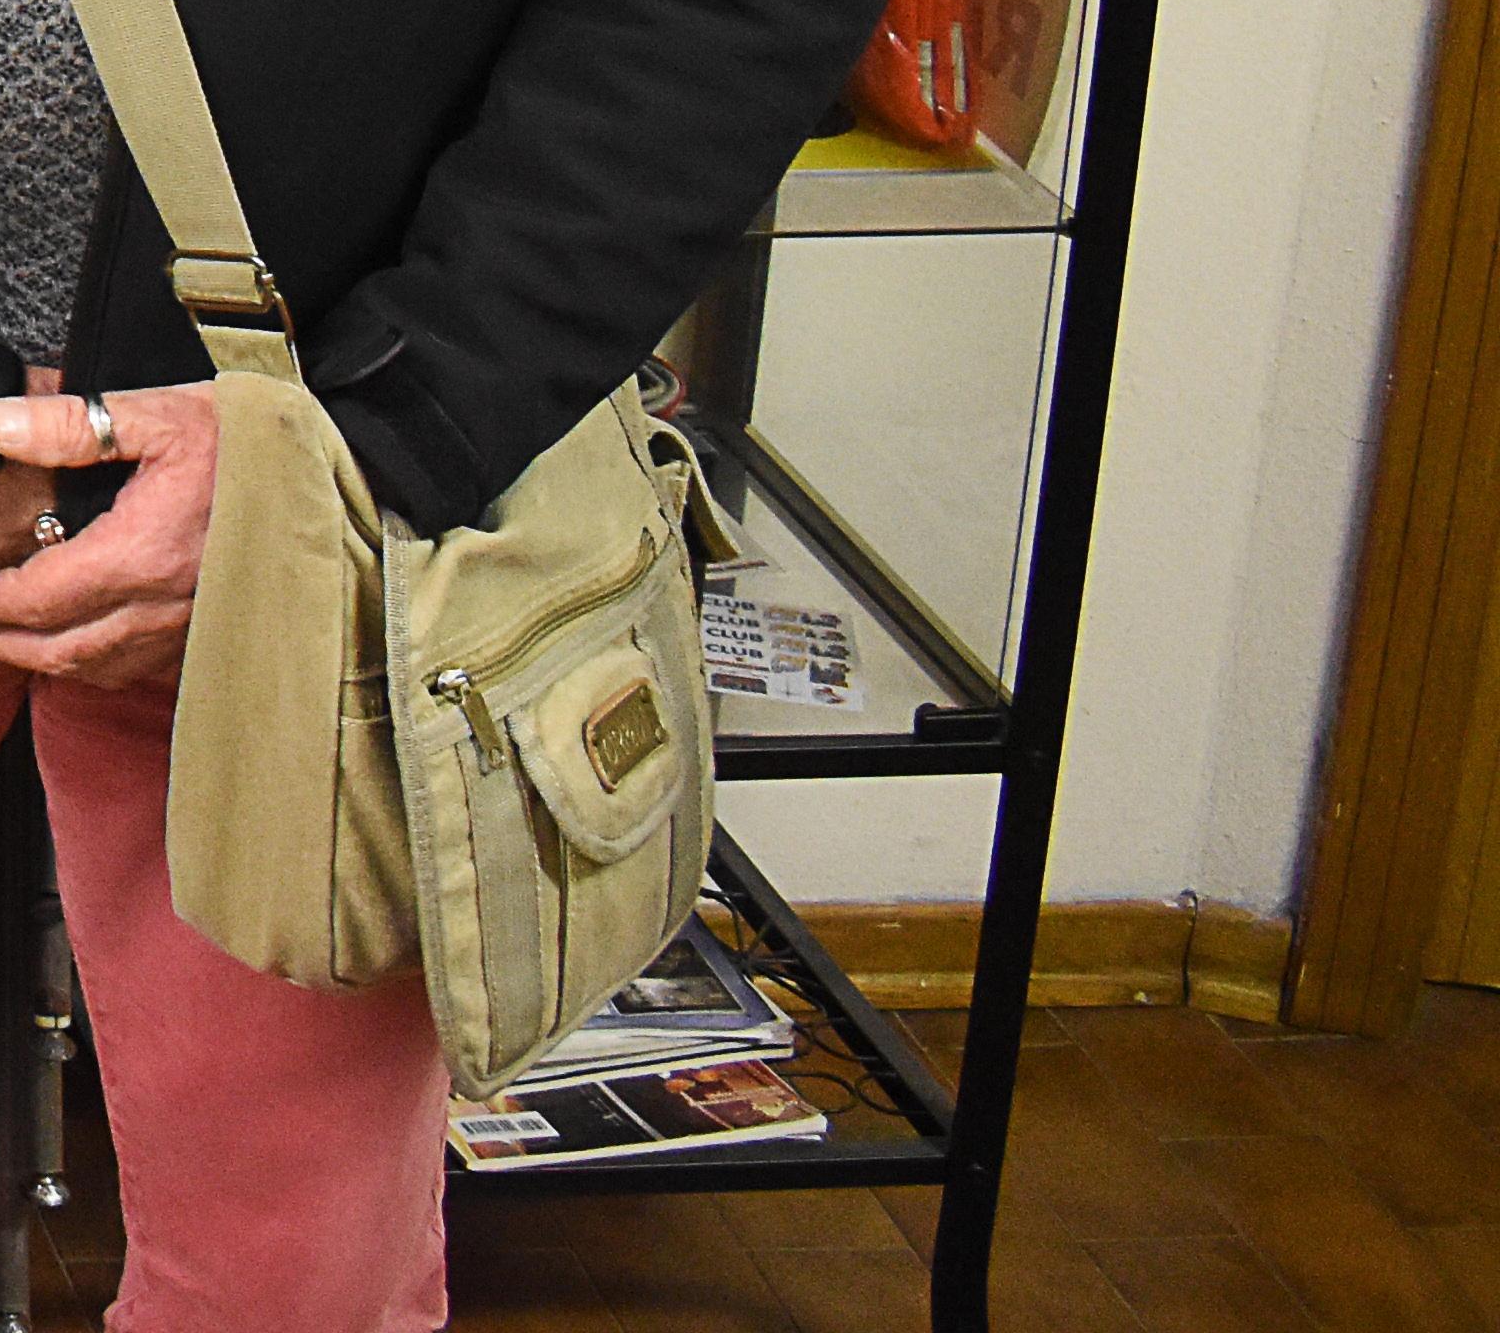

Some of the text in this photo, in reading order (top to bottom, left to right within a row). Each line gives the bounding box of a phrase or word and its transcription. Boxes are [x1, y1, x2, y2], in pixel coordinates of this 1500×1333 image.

[703, 613, 760, 628] CLUB
[704, 627, 764, 643] CLUB
[704, 643, 764, 659] CLUB
